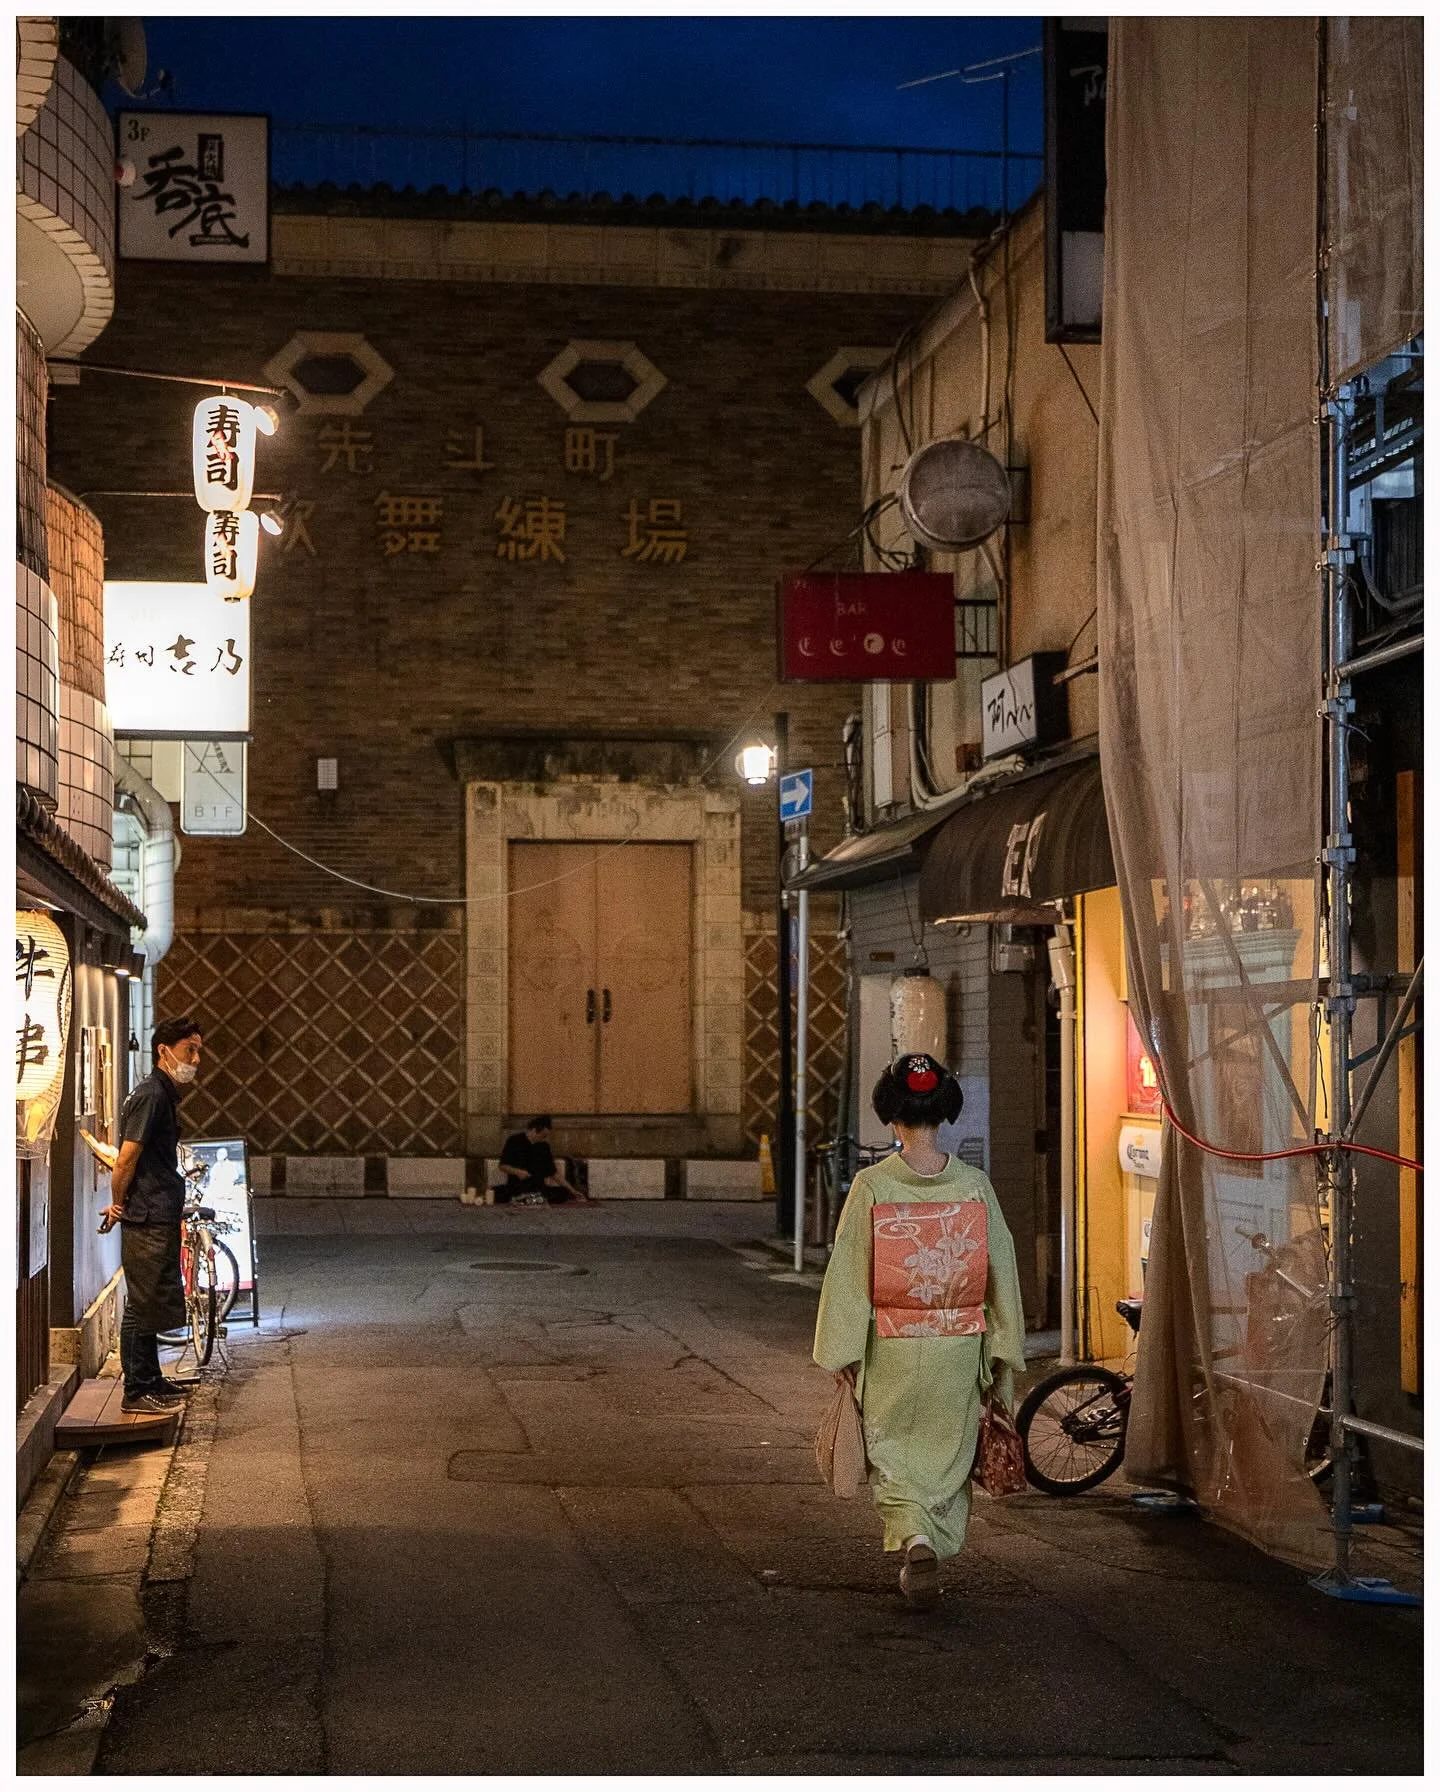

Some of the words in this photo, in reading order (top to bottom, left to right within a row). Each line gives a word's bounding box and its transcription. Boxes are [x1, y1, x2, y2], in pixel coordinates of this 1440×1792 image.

[127, 119, 150, 142] 3F
[206, 404, 241, 491] 寿司
[317, 424, 622, 481] 先斗町
[212, 512, 240, 580] 寿司
[836, 603, 867, 616] BAR
[194, 806, 233, 818] B1F
